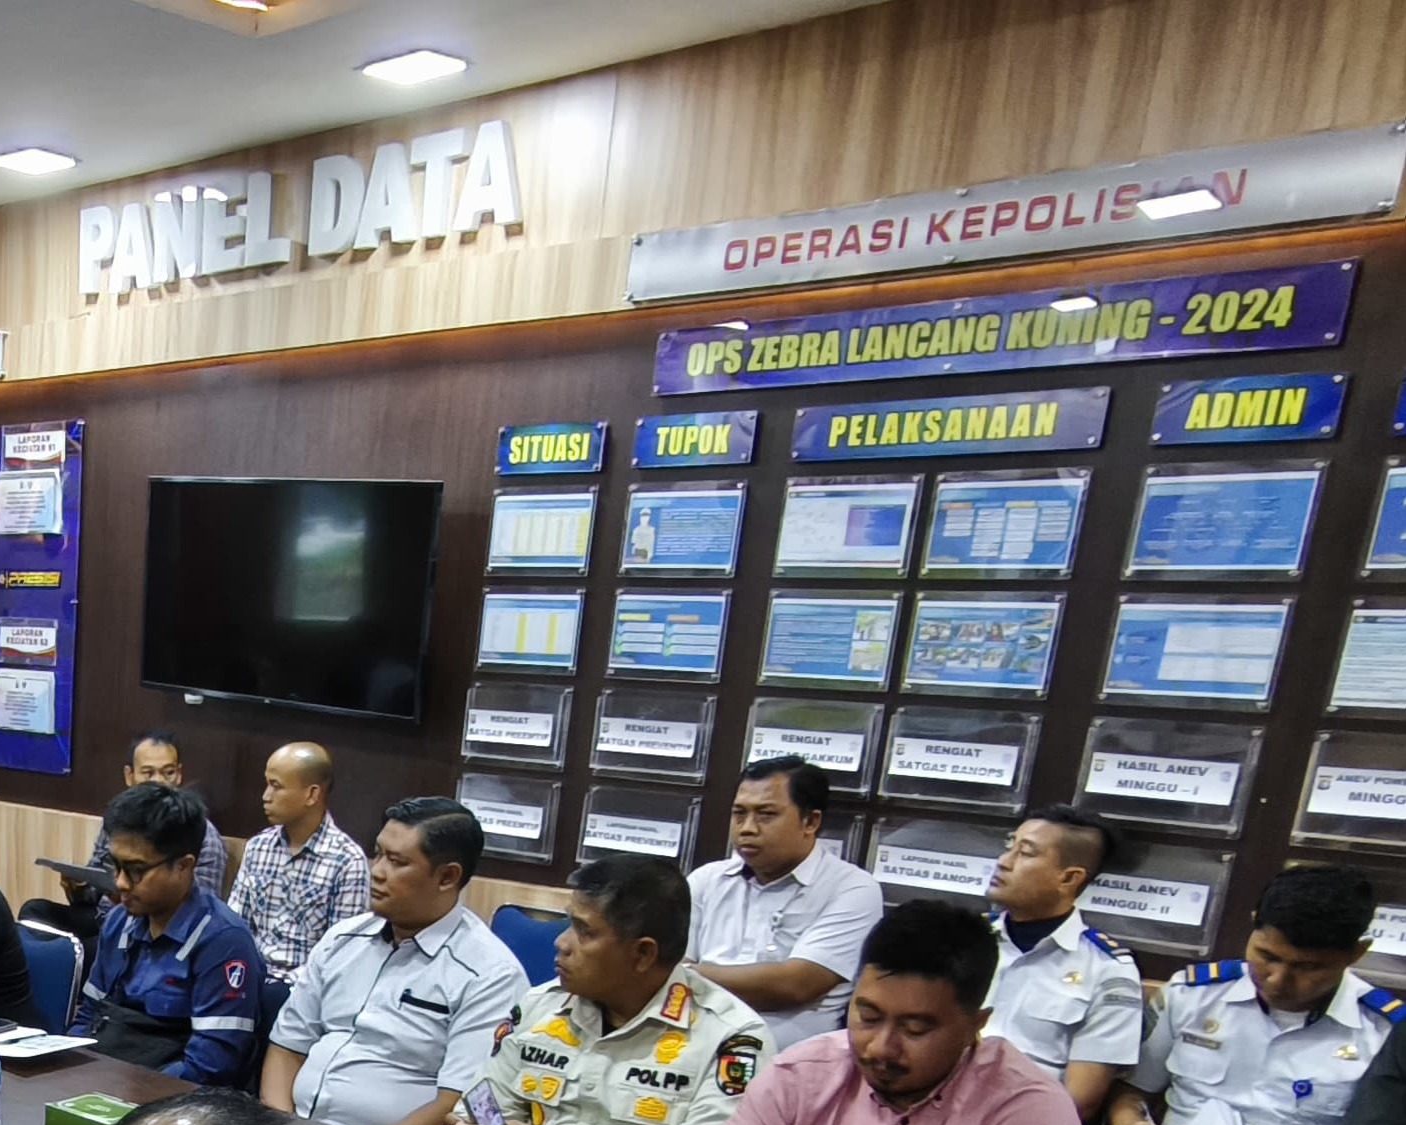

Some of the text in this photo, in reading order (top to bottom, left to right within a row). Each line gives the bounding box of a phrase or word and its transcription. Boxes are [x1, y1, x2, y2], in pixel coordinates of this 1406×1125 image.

[80, 119, 523, 296] PANEL DATA
[723, 217, 910, 272] OPERASI
[686, 339, 743, 377] OPS
[747, 330, 840, 373] ZEBRA
[846, 314, 1002, 365] LANCANG
[1006, 299, 1154, 351] KUNING
[1181, 285, 1296, 336] 2024
[1185, 388, 1308, 430] ADMIN
[828, 402, 1058, 448] PELAKSANAAN
[508, 433, 592, 465] SITUASI
[656, 424, 732, 456] TUPOK
[625, 724, 670, 735] RENGIAT
[781, 734, 832, 746] RENGIAT
[802, 753, 854, 764] GAKKUM
[925, 745, 983, 758] RENGIAT
[897, 760, 948, 773] SATGAS
[1117, 760, 1209, 777] HASIL ANEV
[1115, 779, 1178, 794] MINGGU
[883, 865, 984, 886] SATGAS BANOPS
[1136, 884, 1180, 897] ANEV
[1090, 896, 1148, 910] MINGGU
[520, 1044, 570, 1071] AZHAR
[626, 1067, 691, 1092] POL PP
